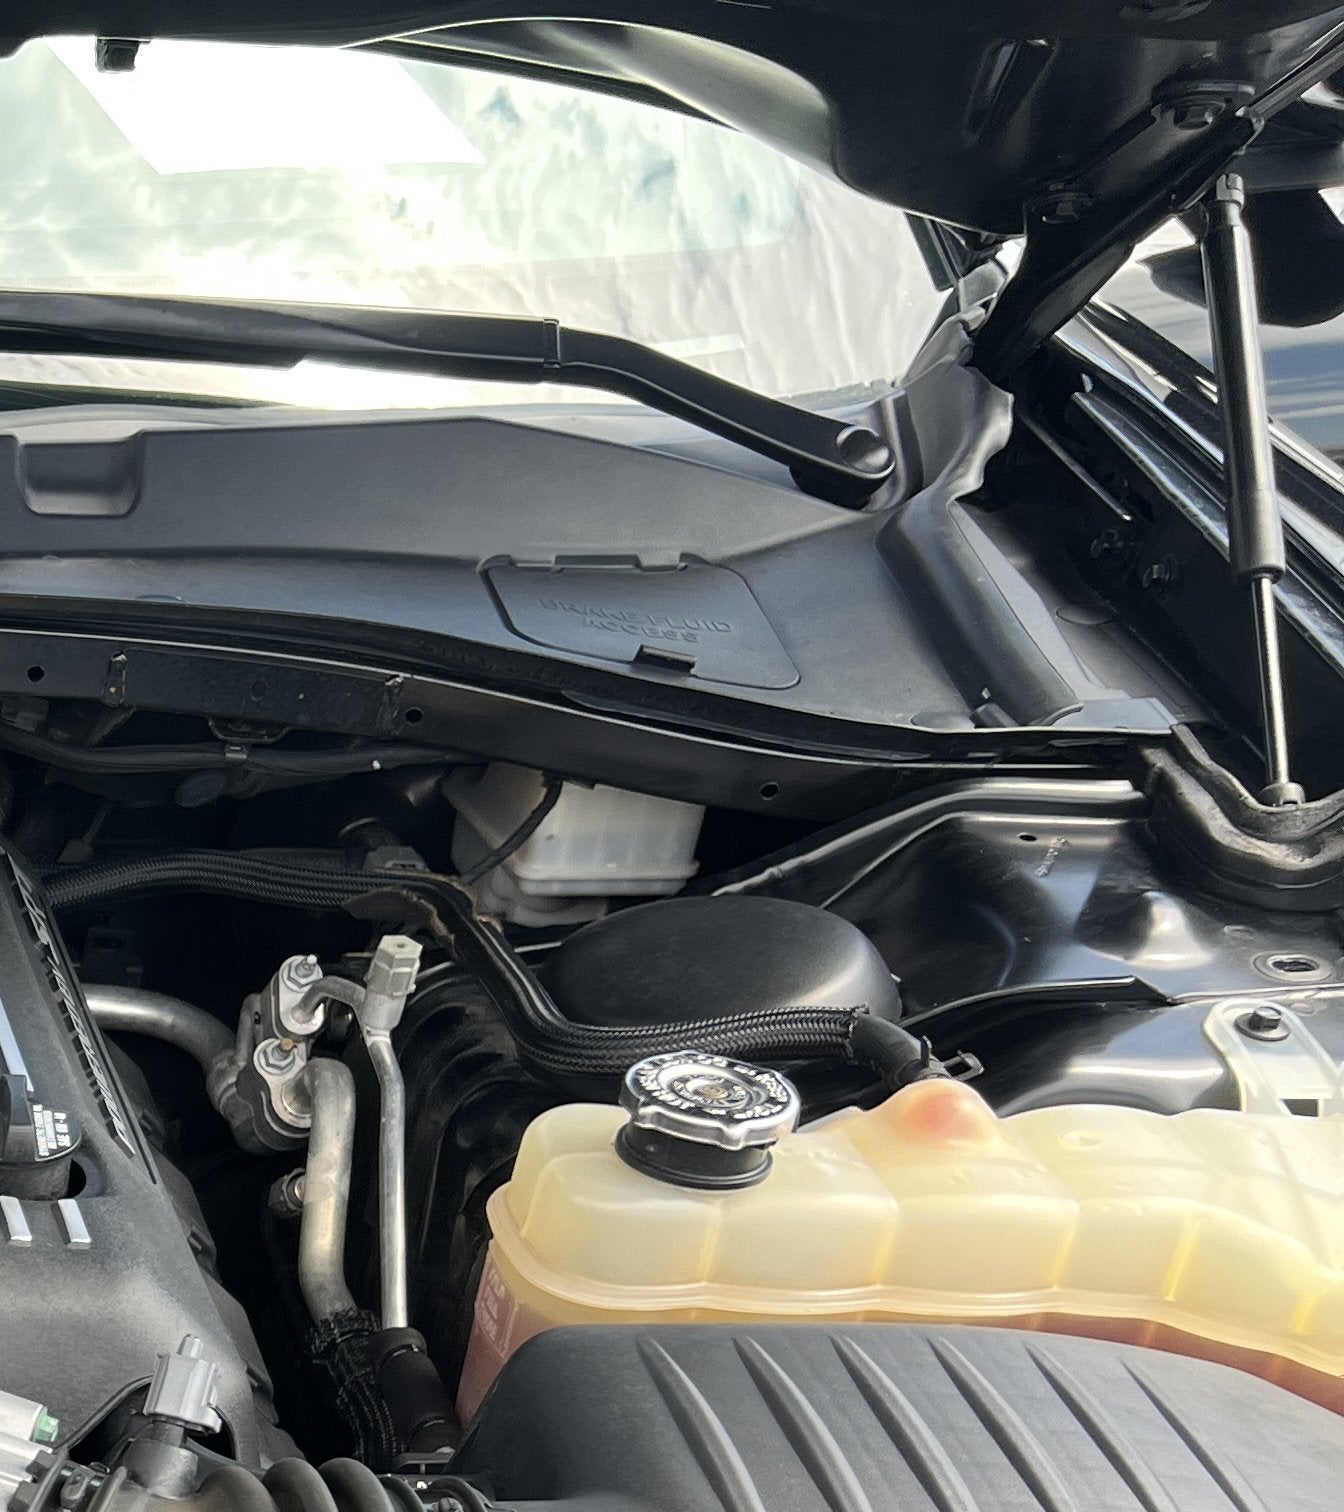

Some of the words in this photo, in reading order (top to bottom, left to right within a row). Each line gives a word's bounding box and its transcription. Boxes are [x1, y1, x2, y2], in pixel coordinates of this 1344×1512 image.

[540, 598, 642, 624] BRAKE
[647, 614, 733, 633] FLUID
[583, 617, 699, 643] ACCESS
